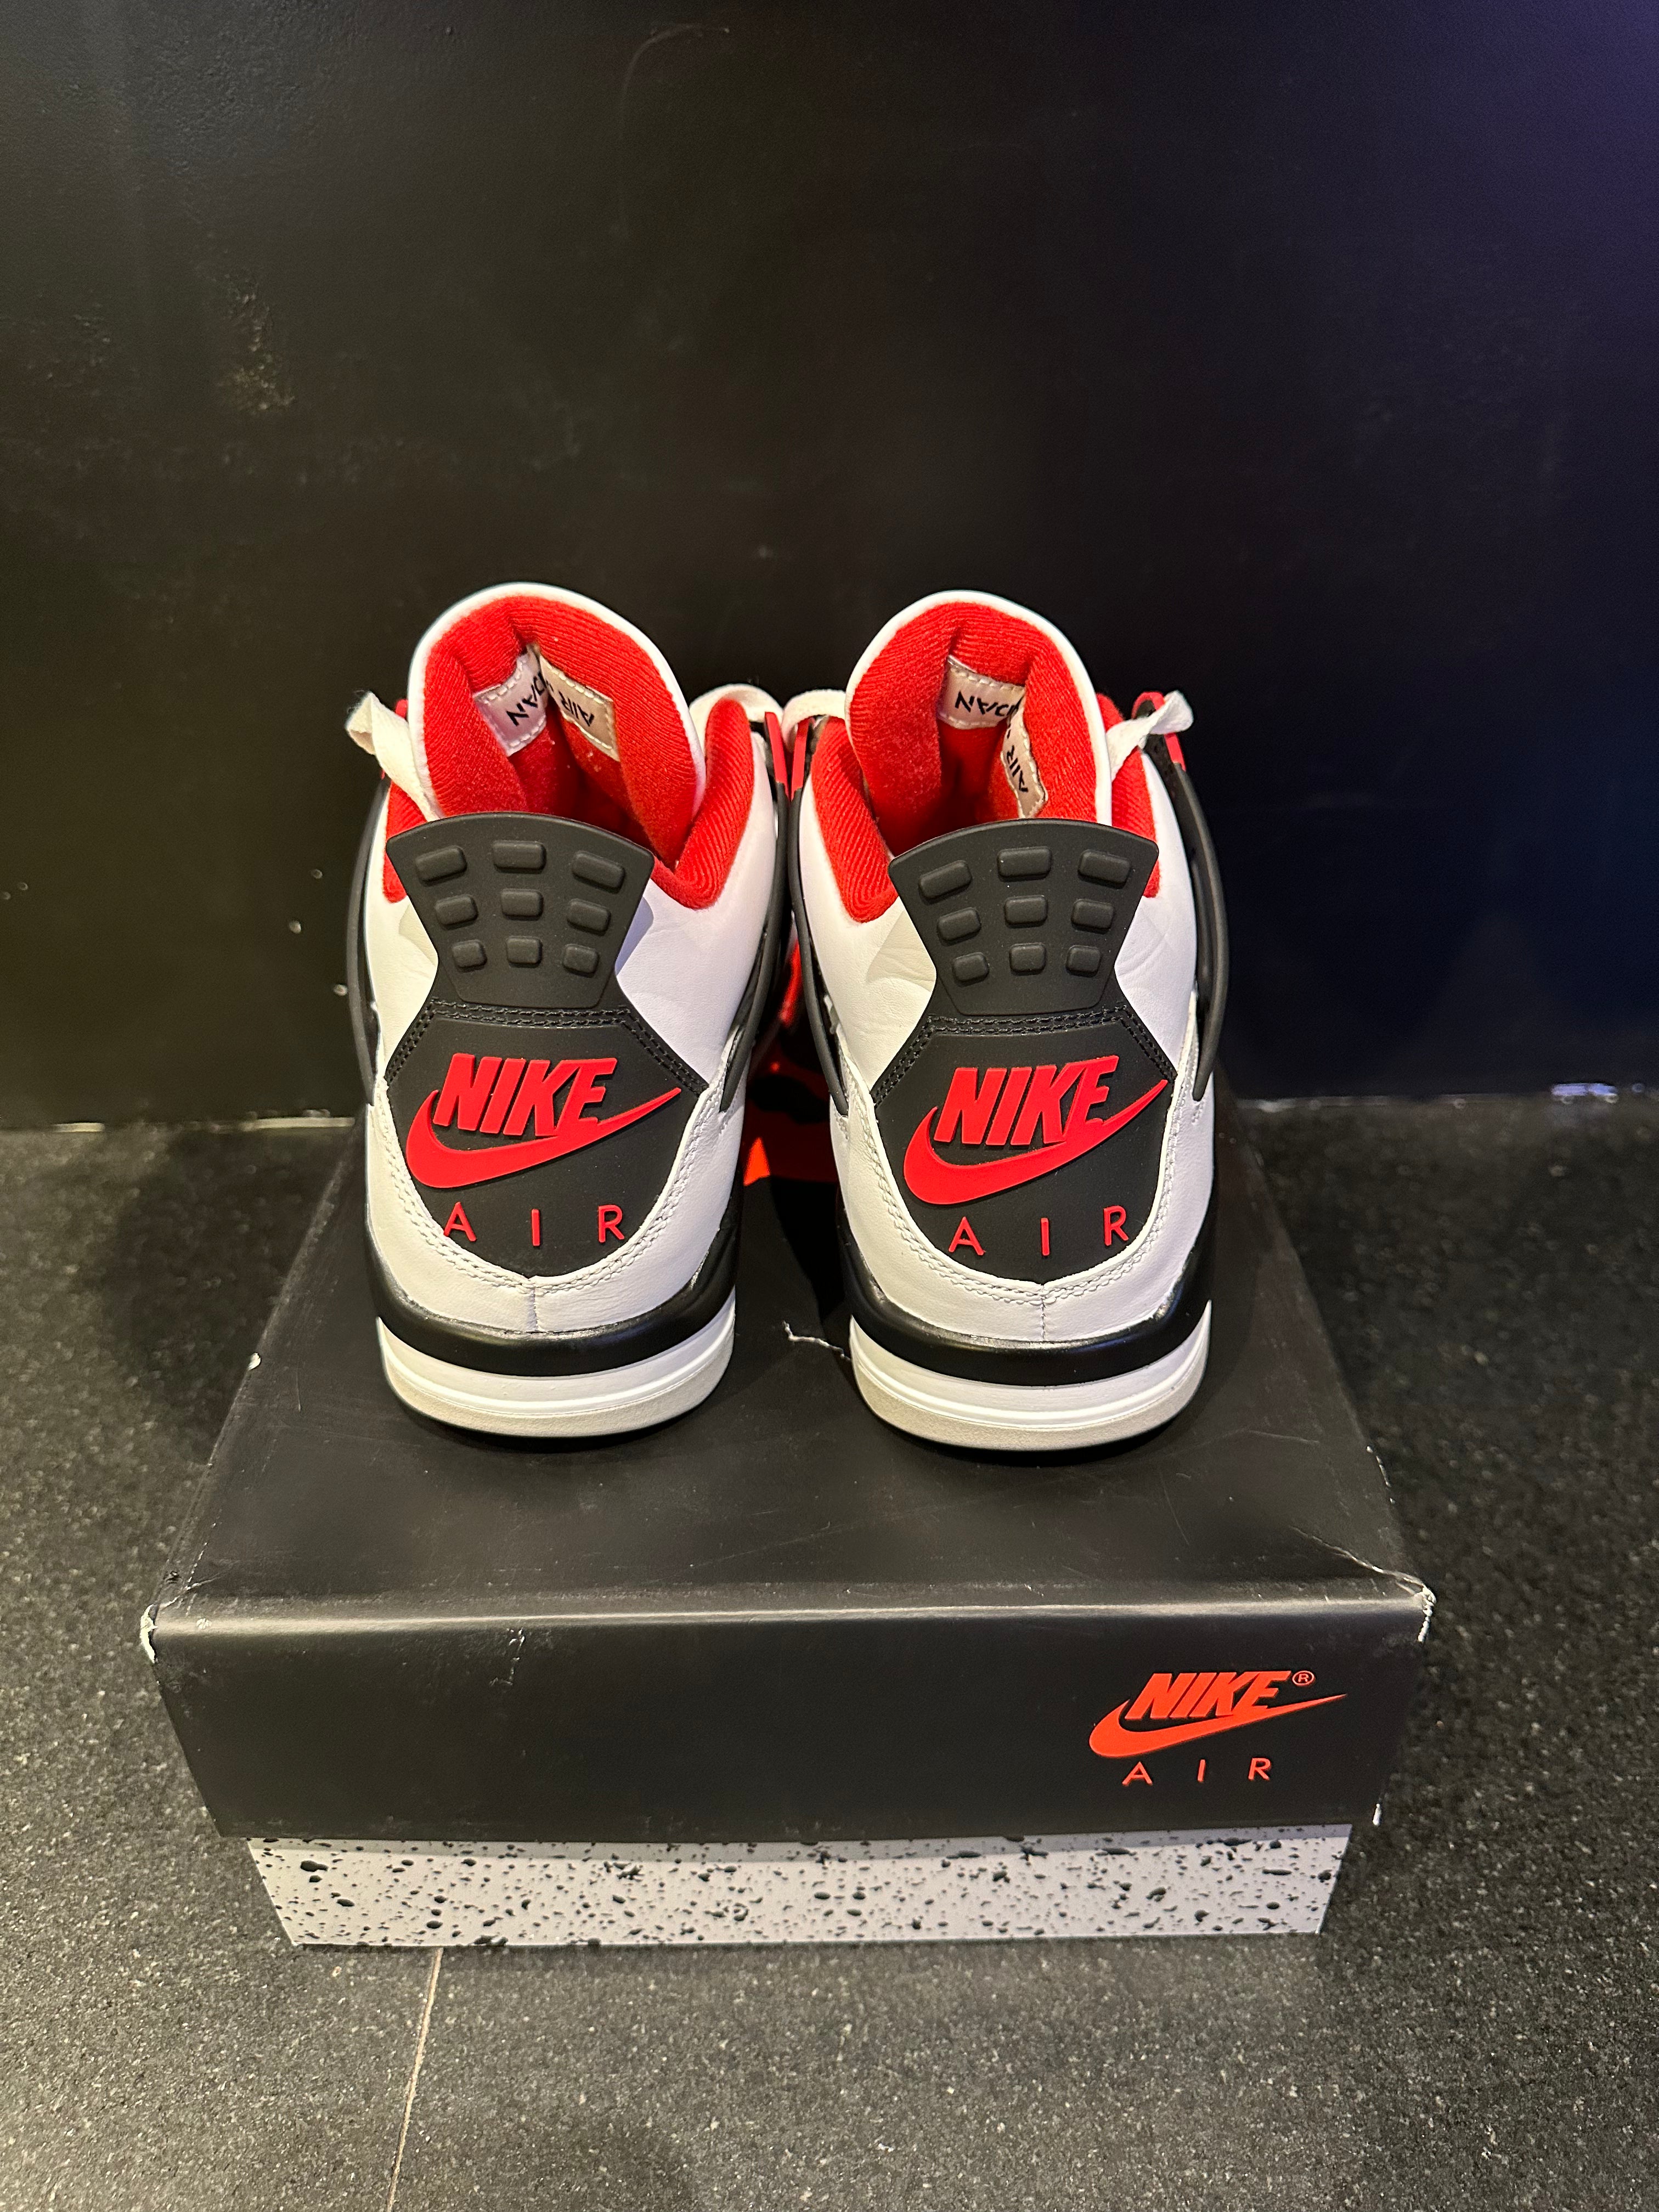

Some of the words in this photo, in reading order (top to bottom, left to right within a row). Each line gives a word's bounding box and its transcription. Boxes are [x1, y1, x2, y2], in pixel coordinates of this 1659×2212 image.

[559, 691, 595, 727] AIR
[1007, 745, 1029, 792] AIR
[433, 1053, 618, 1137] NIKE
[934, 1055, 1119, 1145] NIKE
[443, 1201, 625, 1246] AIR
[949, 1205, 1129, 1256] AIR
[1121, 1757, 1272, 1786] AIR
